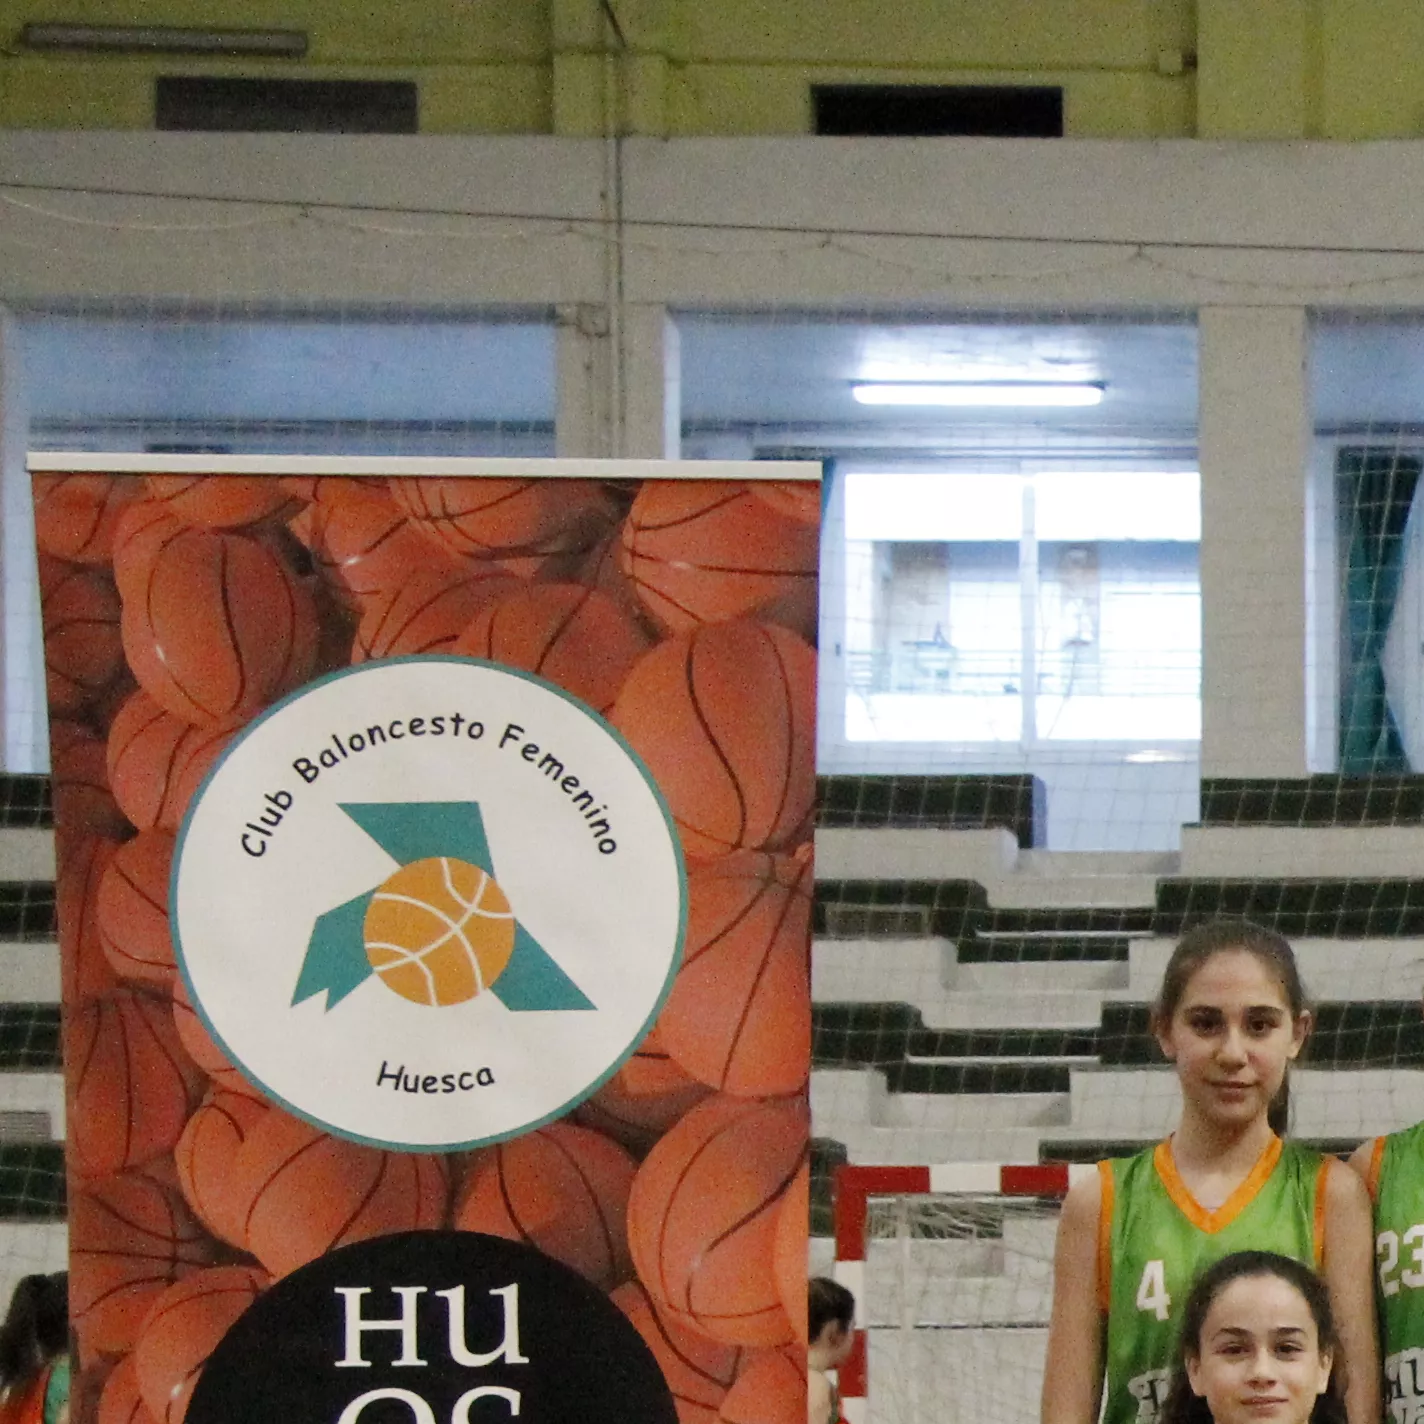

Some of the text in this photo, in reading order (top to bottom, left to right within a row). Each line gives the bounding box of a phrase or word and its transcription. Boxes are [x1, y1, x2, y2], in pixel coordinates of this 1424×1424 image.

[241, 711, 618, 858] Club Baloncesto Femenino
[376, 1060, 496, 1095] Huesca
[333, 1283, 530, 1368] Hu
[1136, 1259, 1172, 1321] 4
